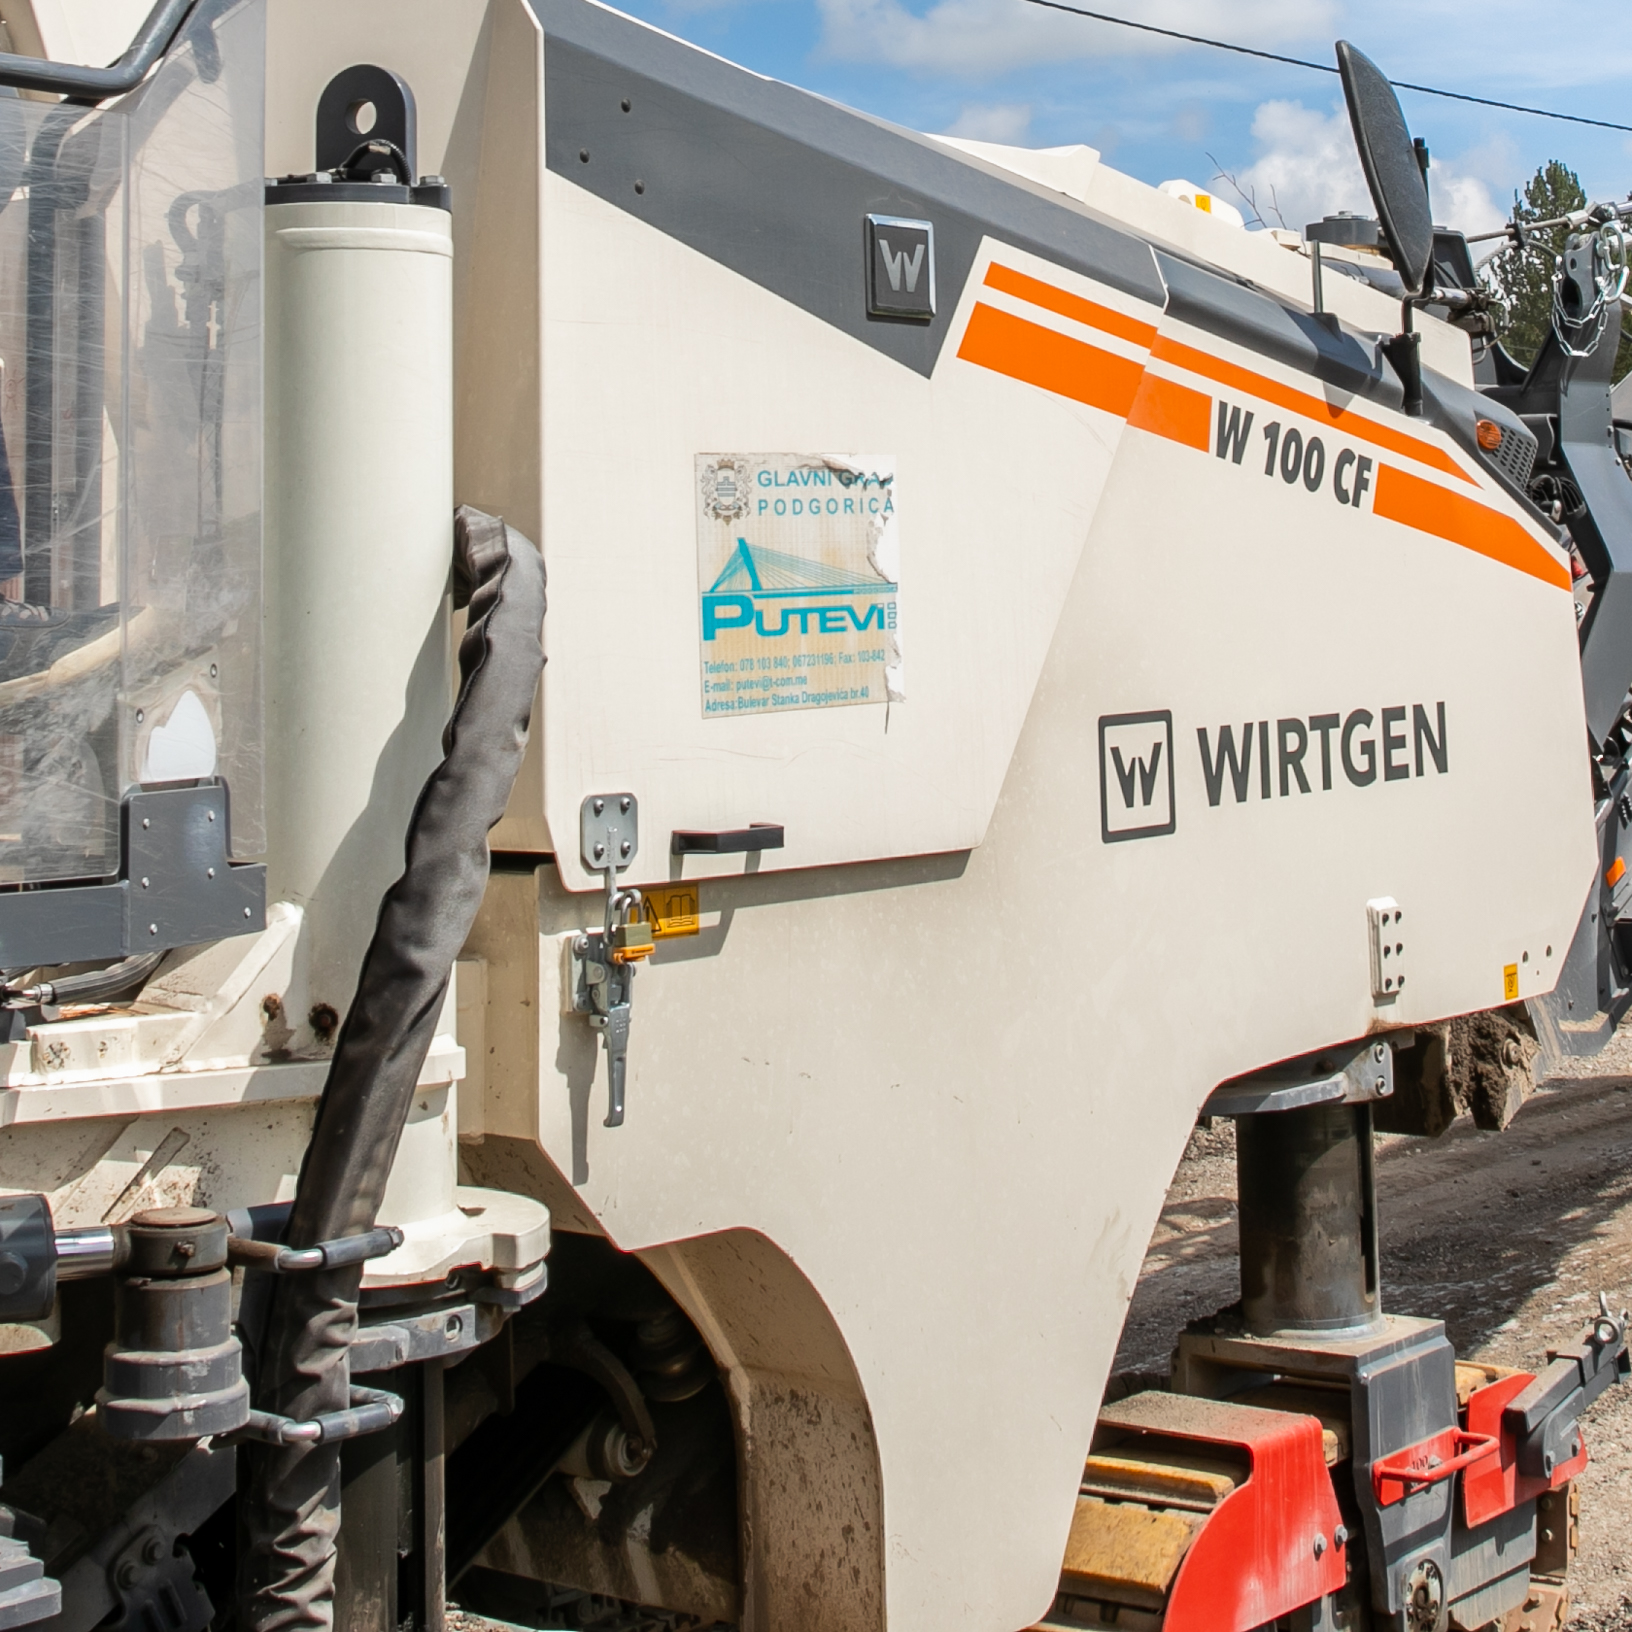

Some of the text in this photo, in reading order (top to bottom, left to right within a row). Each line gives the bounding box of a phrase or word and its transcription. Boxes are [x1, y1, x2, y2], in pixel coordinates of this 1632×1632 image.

[878, 238, 926, 294] W
[1216, 399, 1373, 509] W 100 CF
[757, 469, 833, 487] GLAVNI
[758, 497, 894, 517] PODGORICA
[704, 660, 738, 674] Telefon:
[739, 657, 755, 672] 078
[756, 656, 771, 670] 103
[838, 651, 855, 665] Fax:
[857, 648, 886, 663] 103-842
[704, 678, 734, 694] E-mail:
[771, 692, 800, 707] Stanka
[1110, 701, 1450, 809] W WIRTGEN
